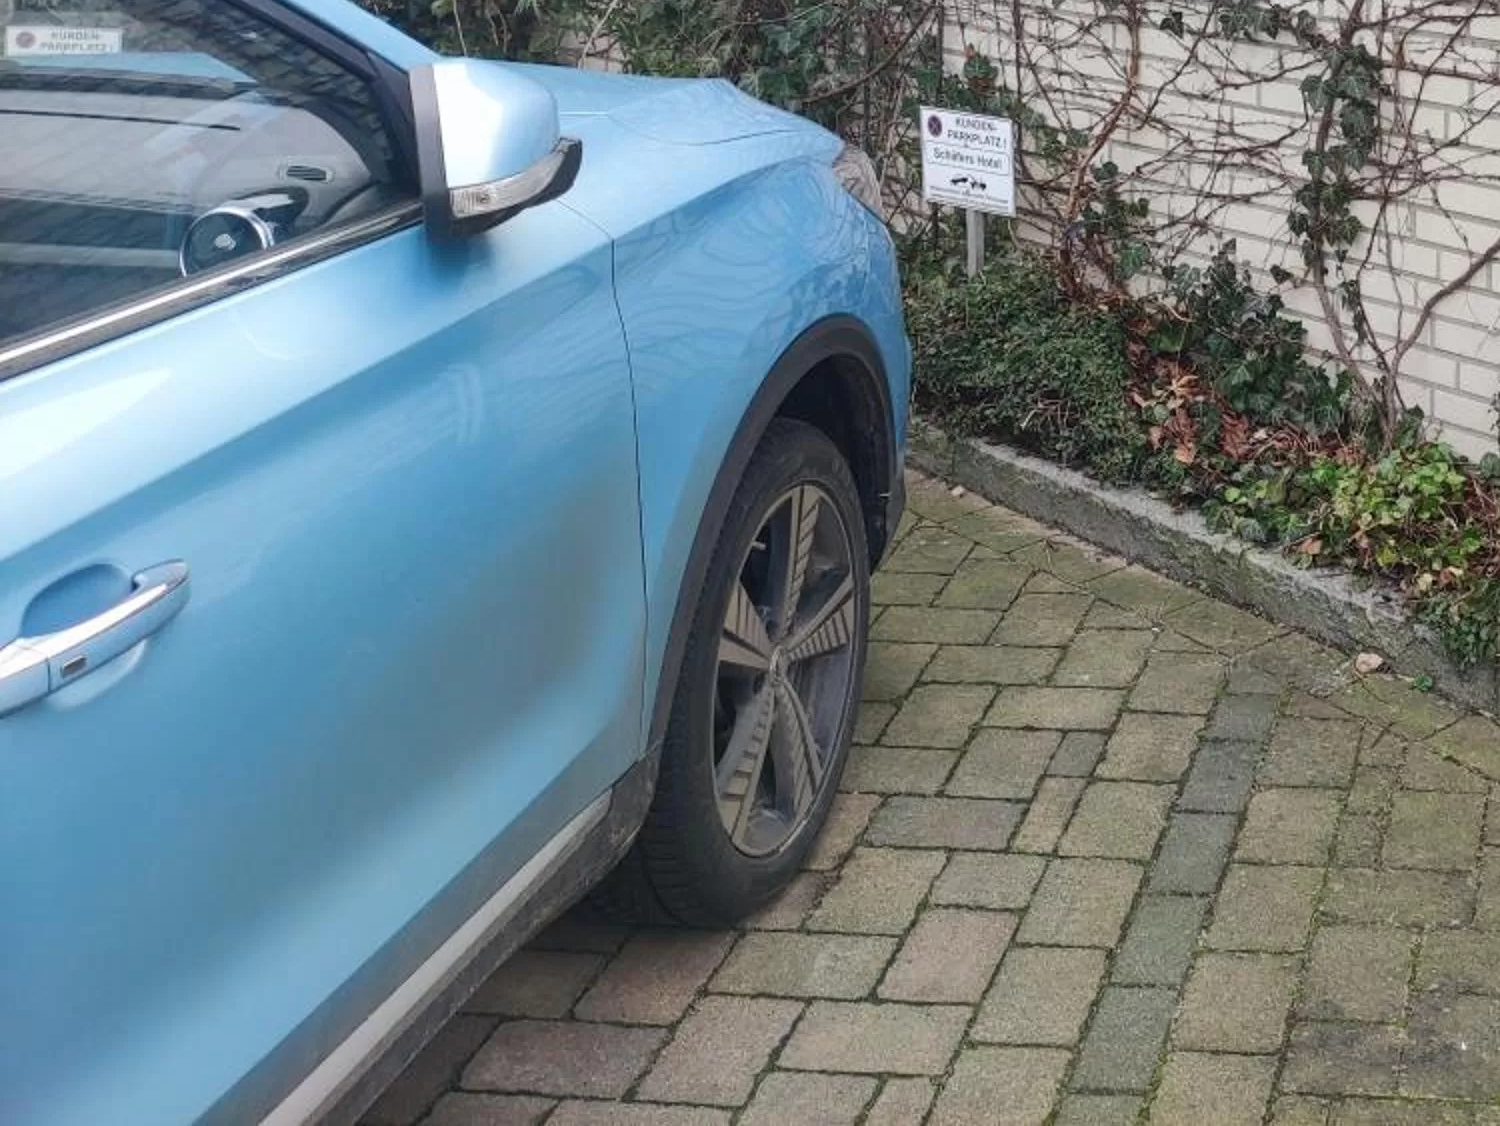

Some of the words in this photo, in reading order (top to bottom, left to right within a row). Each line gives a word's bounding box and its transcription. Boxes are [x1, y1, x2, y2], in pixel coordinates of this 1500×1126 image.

[955, 117, 998, 131] KUNDEN-
[933, 146, 974, 164] Schäfers
[977, 154, 1003, 170] Hotel
